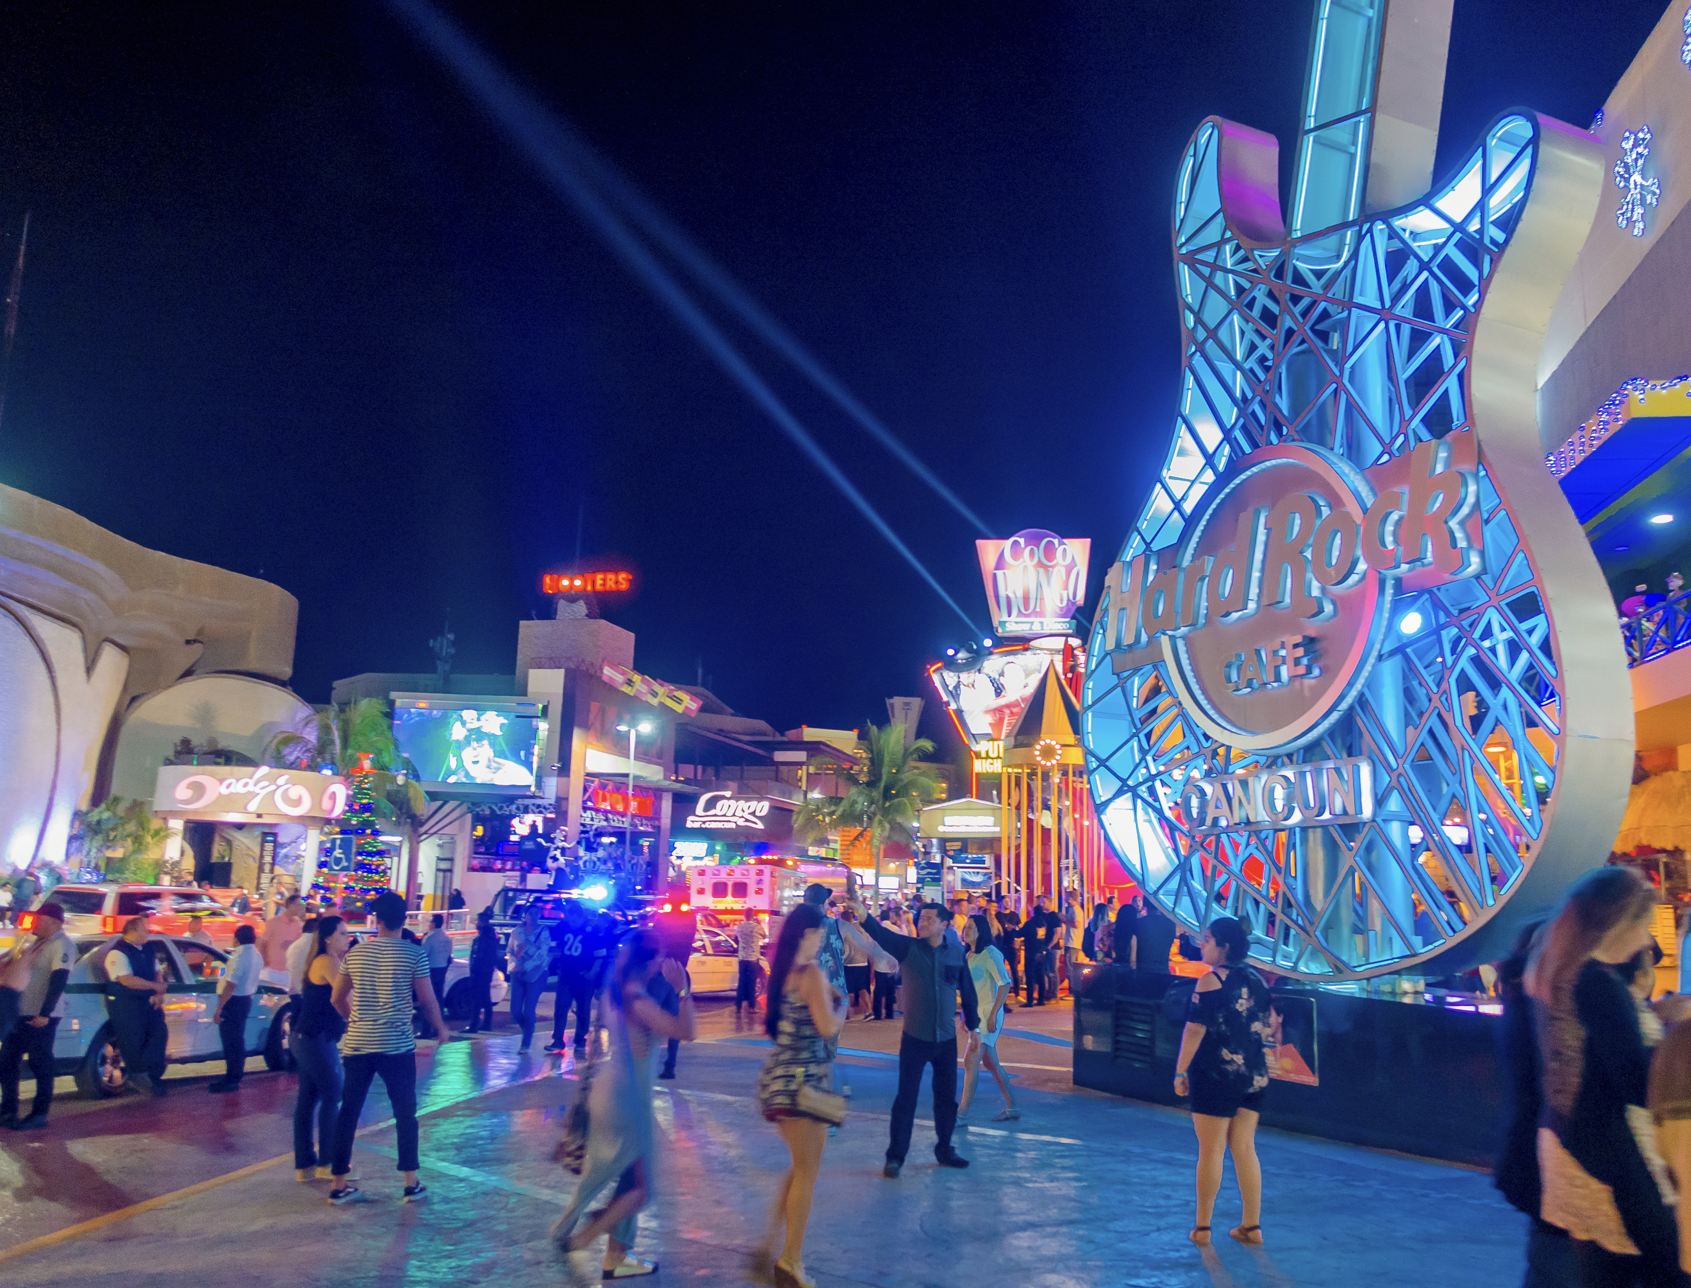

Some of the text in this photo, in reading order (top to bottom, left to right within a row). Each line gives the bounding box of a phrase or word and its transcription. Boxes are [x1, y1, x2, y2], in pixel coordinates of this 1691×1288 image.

[1105, 440, 1482, 652] Hard Rock
[993, 564, 1083, 621] BONGO
[1223, 634, 1318, 695] CAFE
[695, 790, 770, 829] Congo
[1181, 763, 1363, 829] CANCUN
[564, 933, 583, 956] 26
